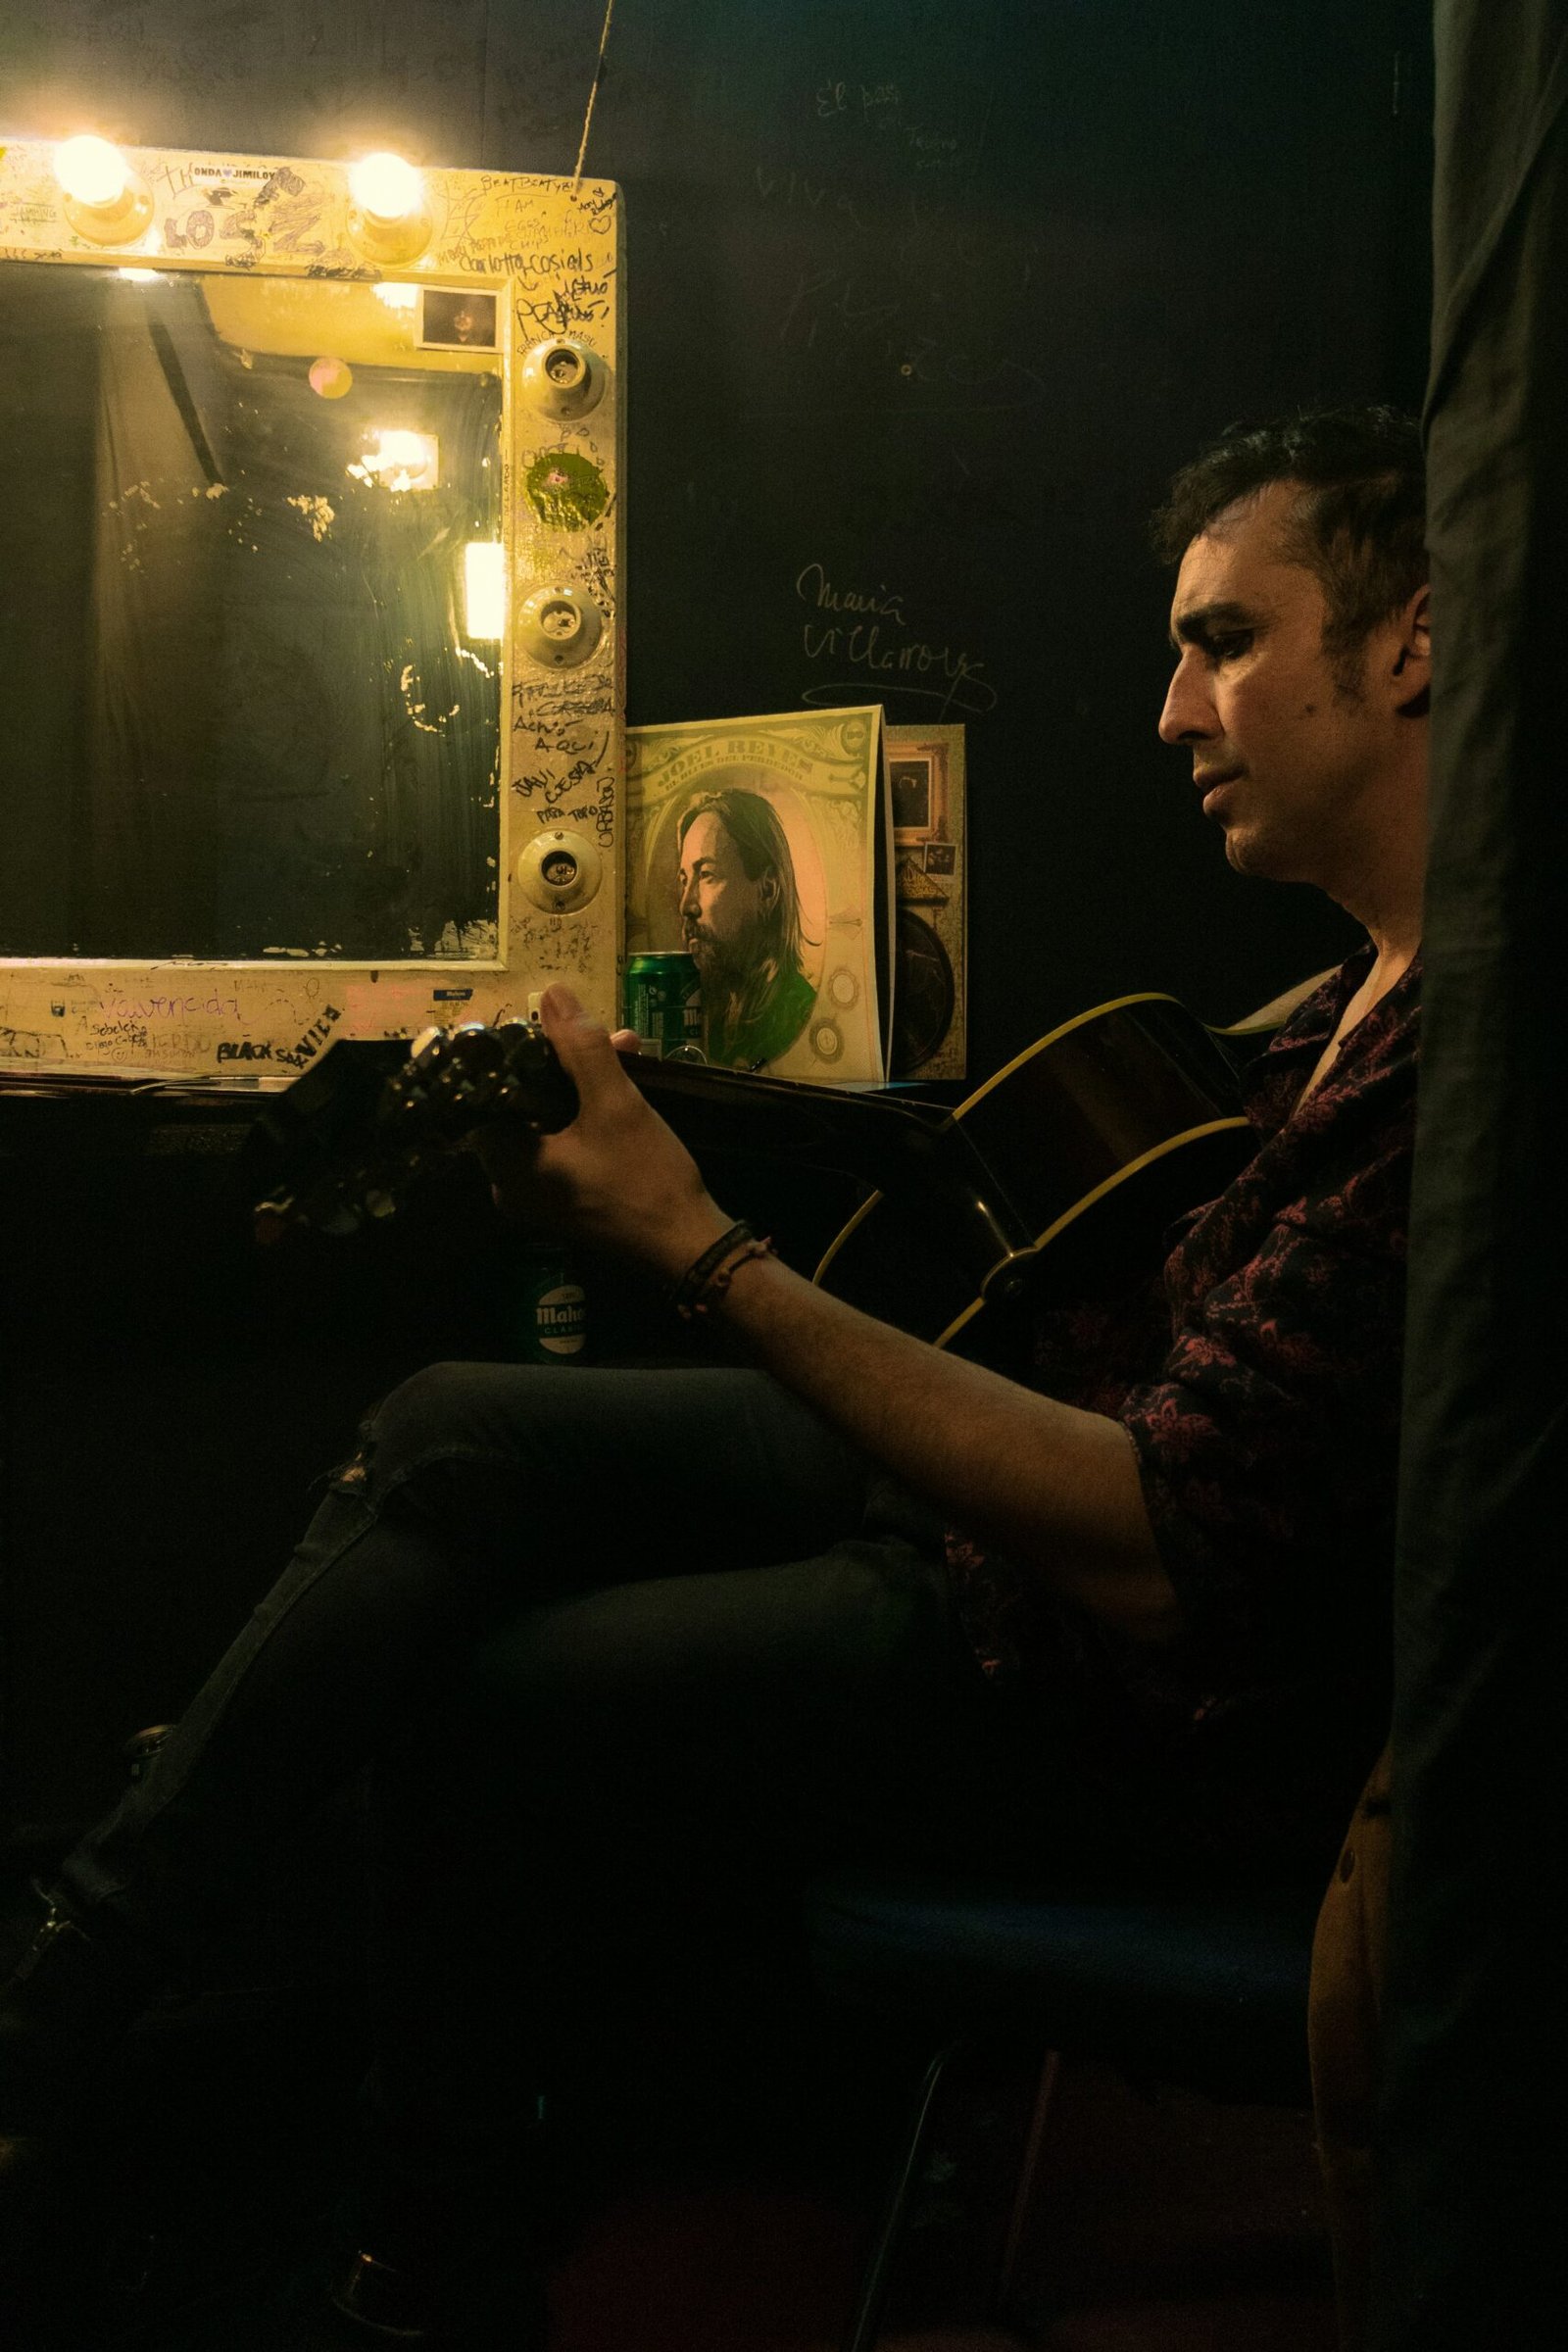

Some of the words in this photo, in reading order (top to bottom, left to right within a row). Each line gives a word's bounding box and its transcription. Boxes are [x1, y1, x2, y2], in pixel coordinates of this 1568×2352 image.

[194, 167, 221, 177] ONDA
[658, 745, 719, 787] JOEL
[727, 739, 813, 773] REYES
[742, 754, 804, 781] PERDEDOR
[217, 1040, 272, 1063] BLACK
